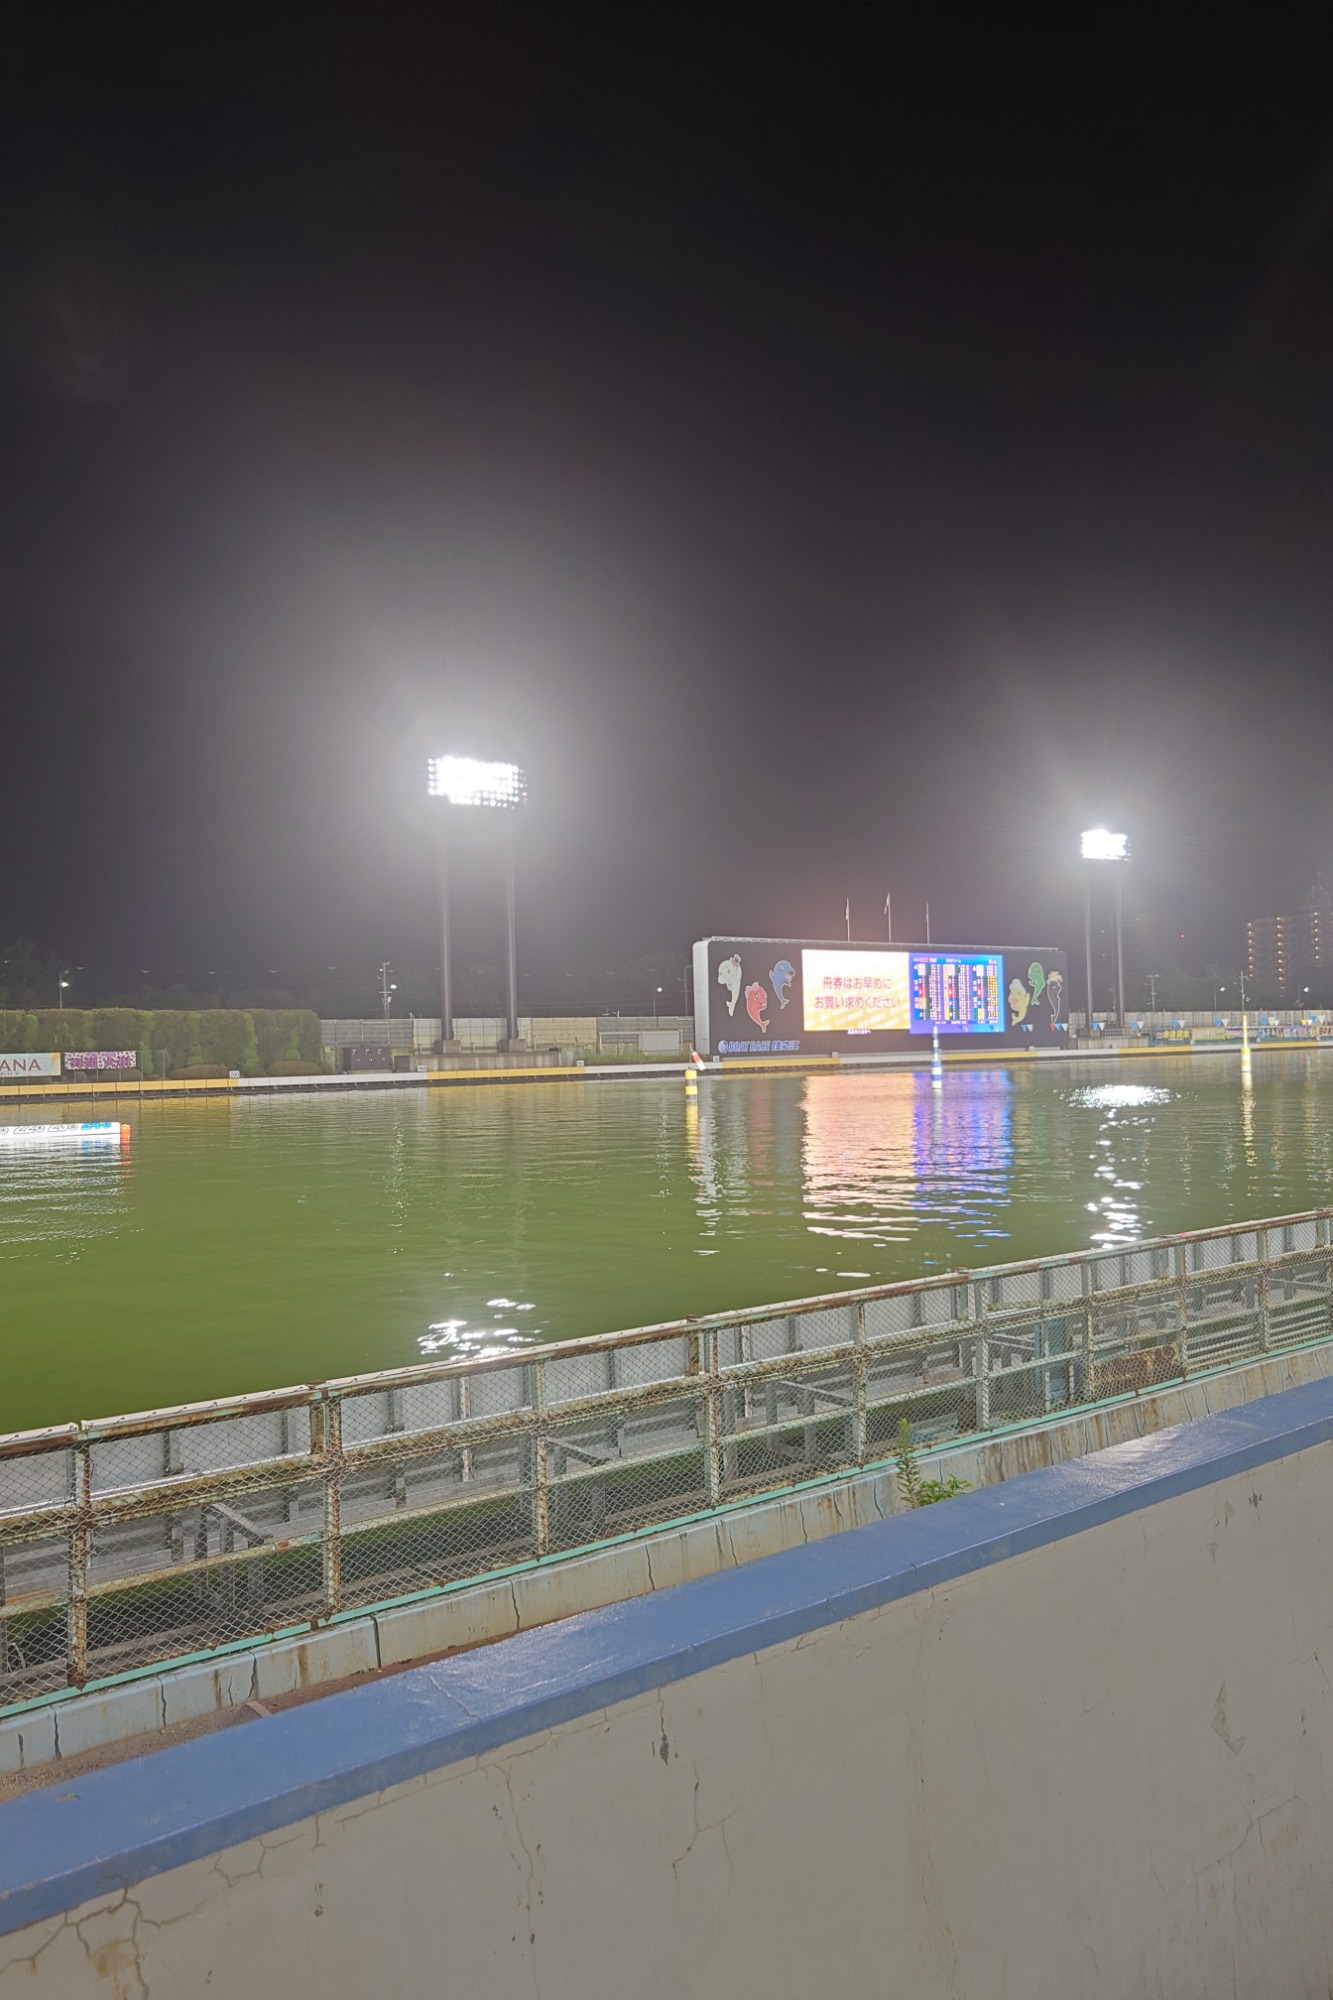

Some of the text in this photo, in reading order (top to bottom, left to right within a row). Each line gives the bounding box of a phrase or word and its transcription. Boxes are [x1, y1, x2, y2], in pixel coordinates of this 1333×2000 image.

[823, 977, 892, 989] 舟券はお早めに
[815, 996, 900, 1009] お買い求めください
[728, 1041, 749, 1052] BOAT
